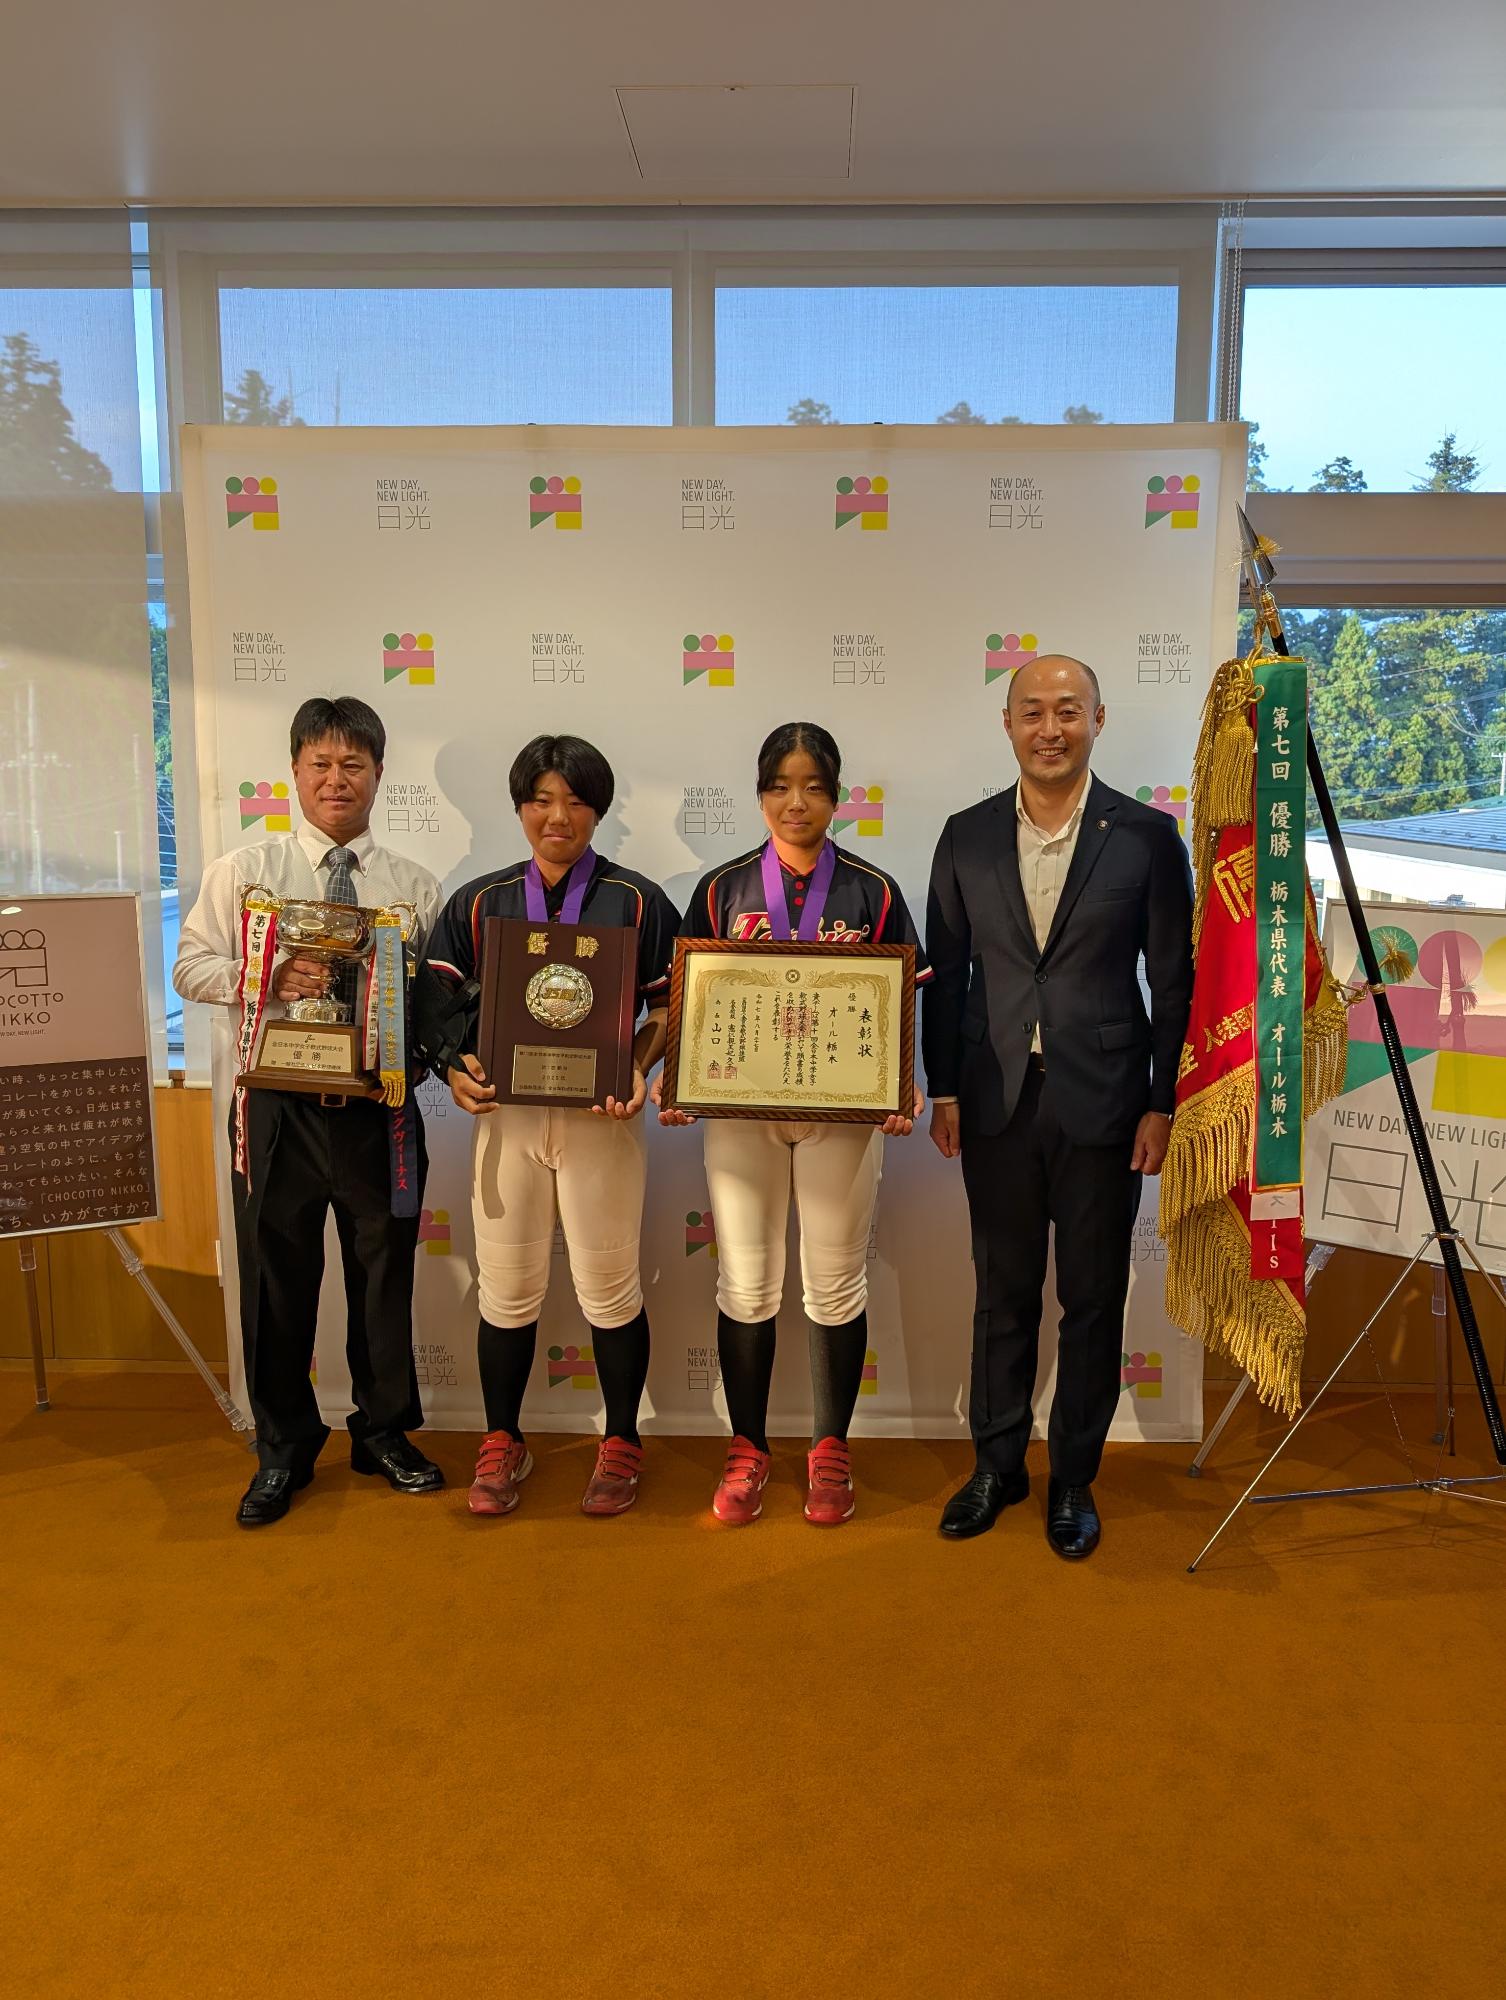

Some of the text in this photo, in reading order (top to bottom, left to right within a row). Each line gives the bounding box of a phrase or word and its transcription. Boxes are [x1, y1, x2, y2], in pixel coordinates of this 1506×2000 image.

[376, 479, 422, 492] NEW DAY,
[681, 479, 726, 491] NEW DAY,
[990, 478, 1036, 490] NEW DAY,
[376, 490, 431, 502] NEW LIGHT.
[681, 490, 736, 502] NEW LIGHT.
[989, 489, 1044, 501] NEW LIGHT.
[377, 505, 432, 531] 日光
[681, 505, 736, 531] 日光
[988, 504, 1044, 530] 日光
[232, 632, 277, 644] NEW DAY,
[532, 633, 576, 645] NEW DAY,
[833, 634, 877, 646] NEW DAY,
[1138, 633, 1183, 645] NEW DAY,
[233, 643, 286, 655] NEW LIGHT.
[532, 644, 585, 656] NEW LIGHT.
[833, 645, 886, 657] NEW LIGHT.
[1138, 645, 1192, 656] NEW LIGHT.
[233, 657, 287, 683] 日光
[532, 658, 585, 684] 日光
[832, 660, 886, 686] 日光
[1137, 659, 1192, 685] 日光
[386, 784, 430, 795] NEW DAY,
[683, 786, 728, 798] NEW DAY,
[386, 795, 439, 807] NEW LIGHT.
[683, 798, 736, 809] NEW LIGHT.
[387, 808, 440, 833] 日光
[683, 811, 737, 836] 日光
[1269, 706, 1292, 1137] 第七回 優勝 栃木県代表 オール栃木
[251, 914, 267, 953] 第七回
[847, 992, 857, 1013] 優勝
[826, 1006, 838, 1064] オール栃木
[857, 1007, 874, 1058] 表彰状
[1333, 1108, 1375, 1131] NEW
[1424, 1121, 1466, 1144] NEW
[1138, 1226, 1159, 1237] LIGH
[414, 1344, 428, 1354] EW
[687, 1347, 708, 1357] NEW
[414, 1354, 428, 1364] EW
[687, 1357, 708, 1368] NEW
